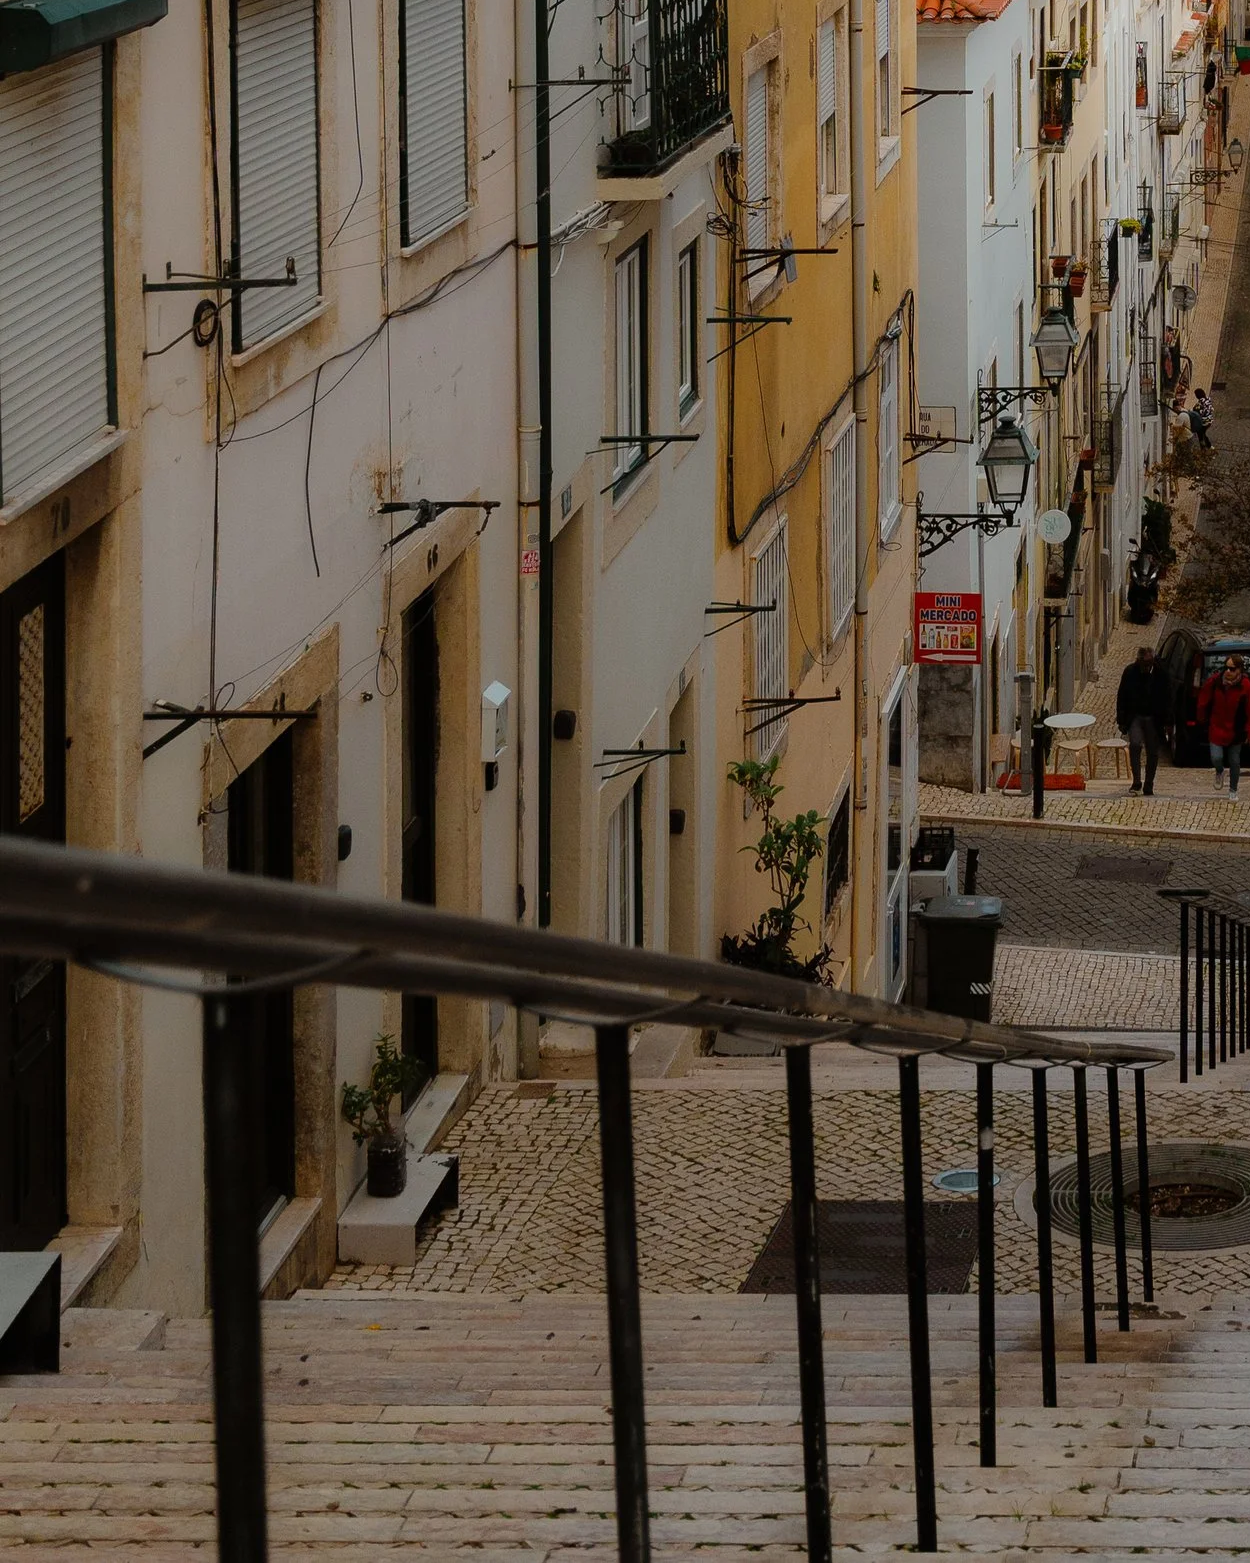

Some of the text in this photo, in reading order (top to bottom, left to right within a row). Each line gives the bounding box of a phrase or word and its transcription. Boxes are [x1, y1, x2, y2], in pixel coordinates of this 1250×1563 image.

[921, 424, 930, 434] DO
[935, 595, 961, 607] MINI
[920, 609, 976, 622] MERCADO
